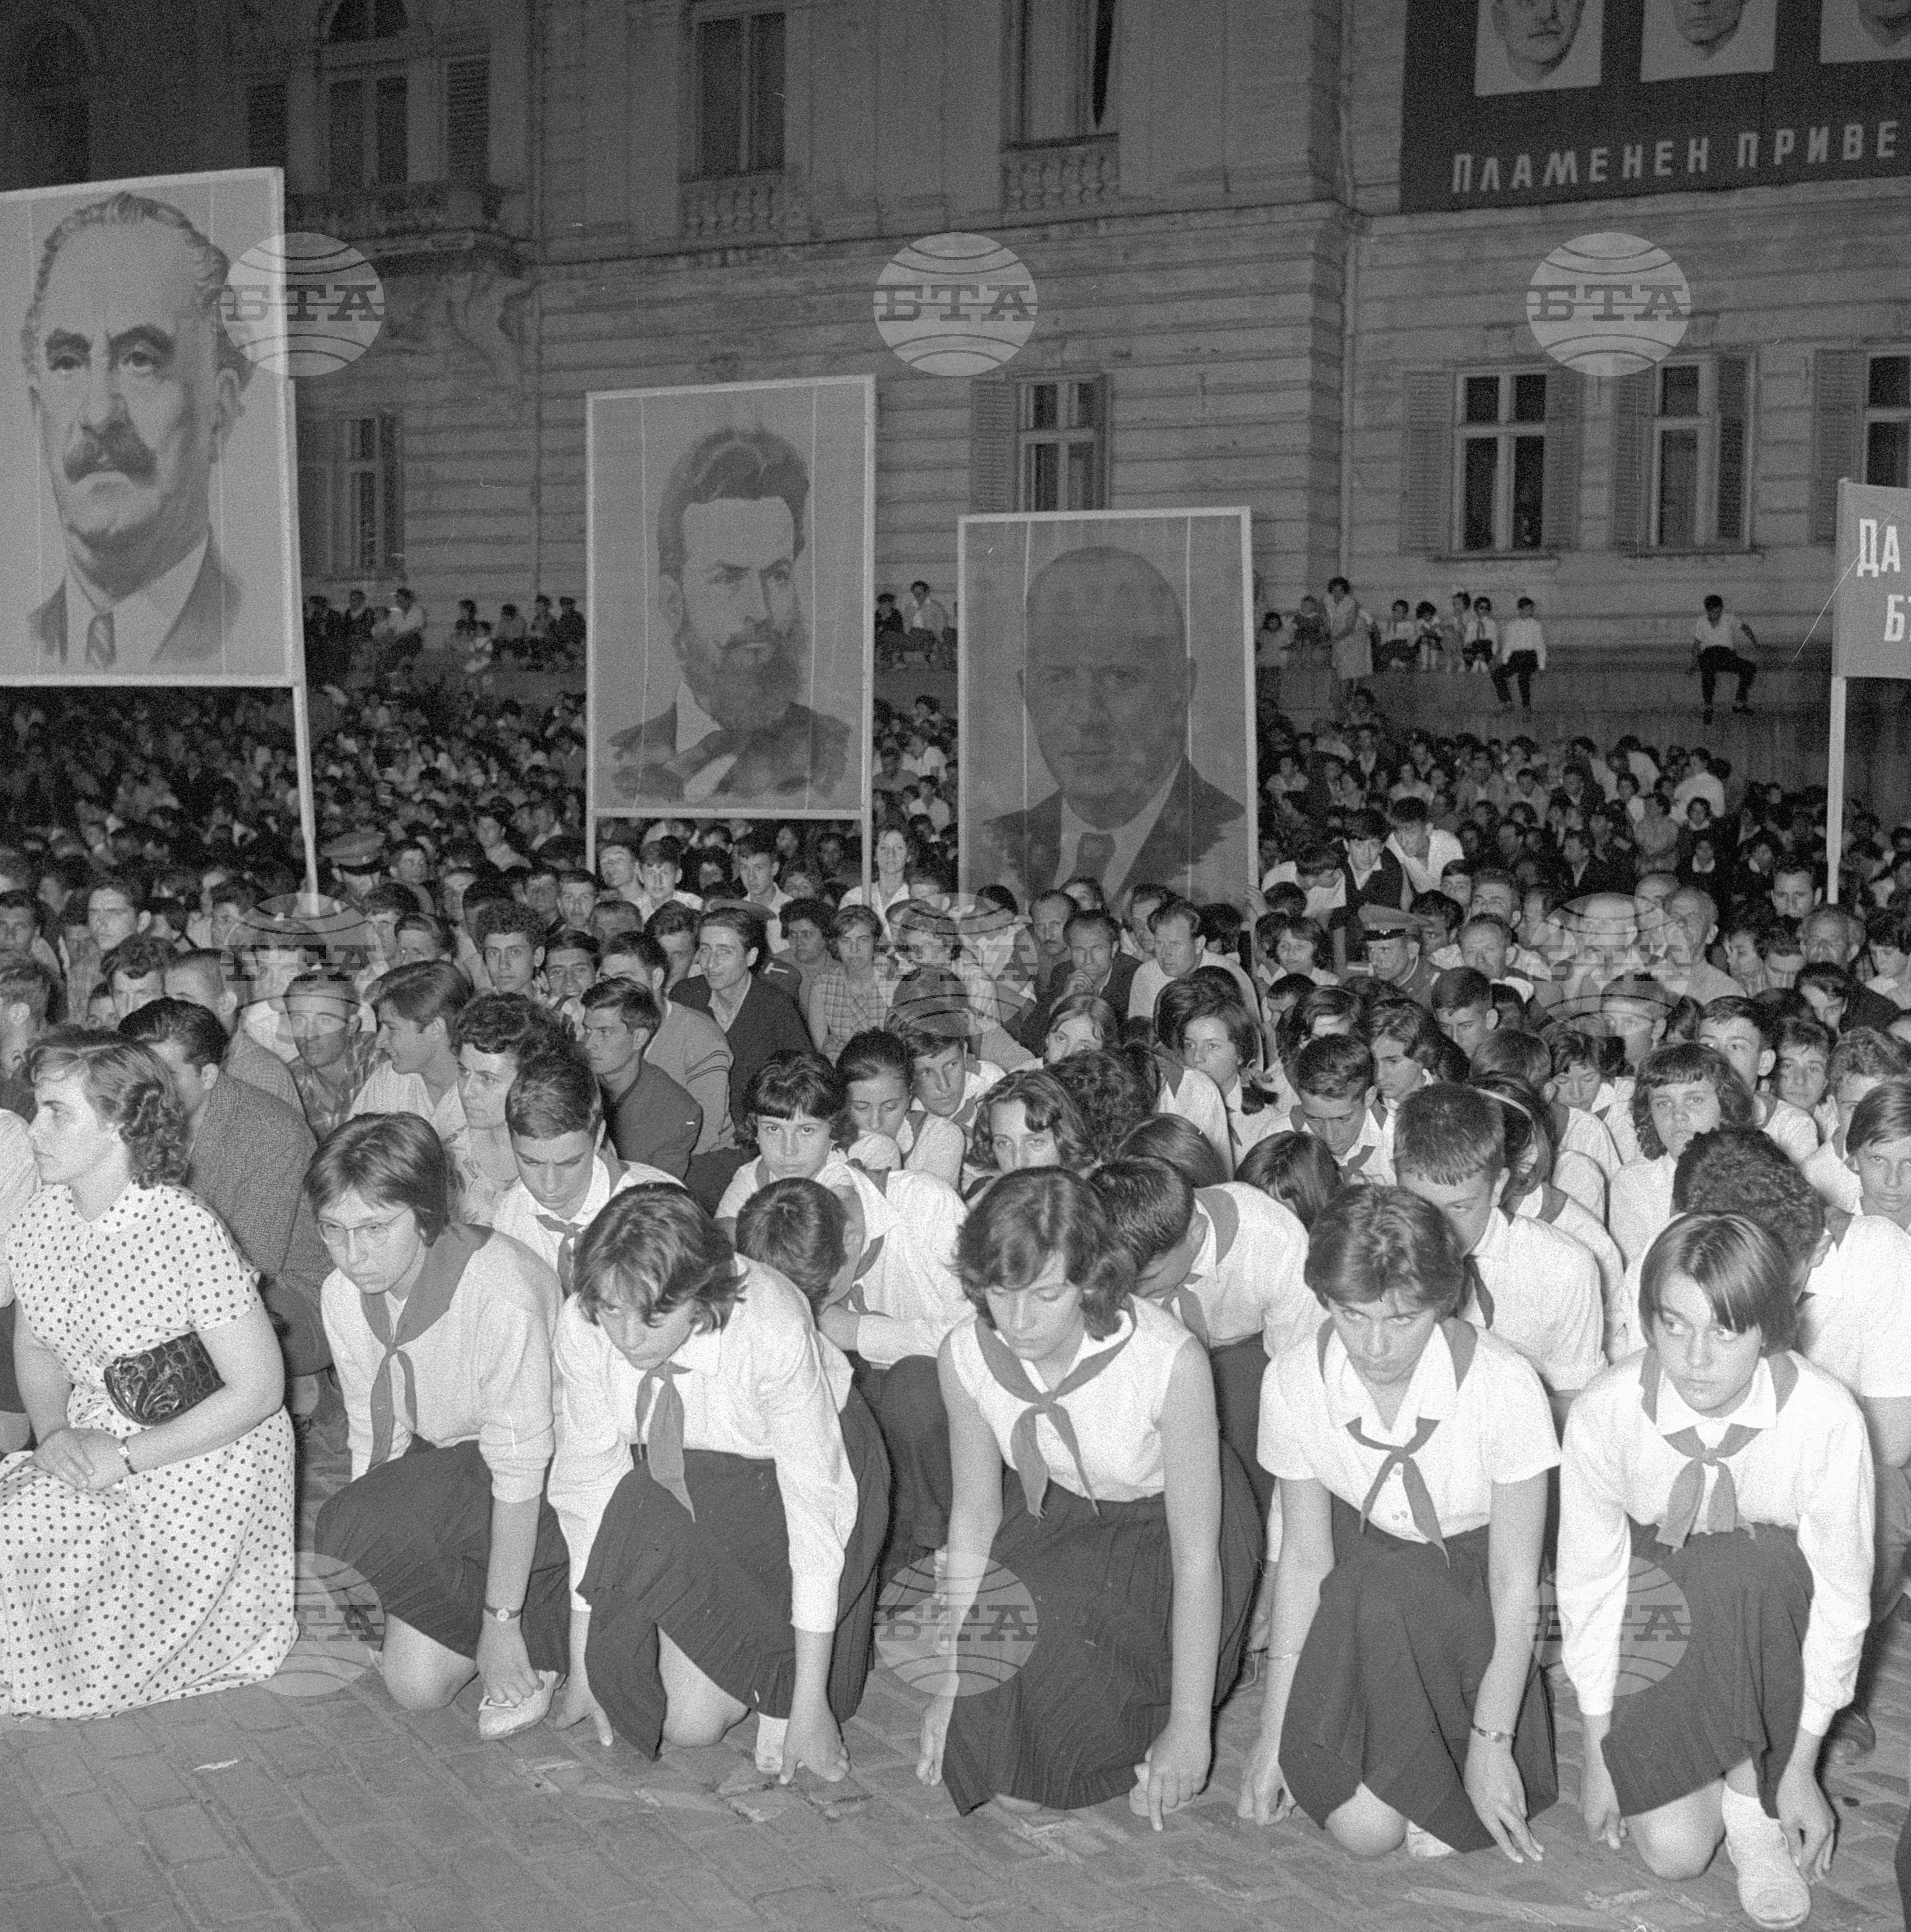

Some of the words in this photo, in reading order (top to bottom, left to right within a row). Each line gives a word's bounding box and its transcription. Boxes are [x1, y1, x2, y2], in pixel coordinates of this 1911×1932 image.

[1452, 138, 1710, 193] ПЛАМЕНЕН
[1738, 121, 1899, 169] ПРИВЕ
[1856, 518, 1901, 578] ДА
[1883, 594, 1911, 642] Б
